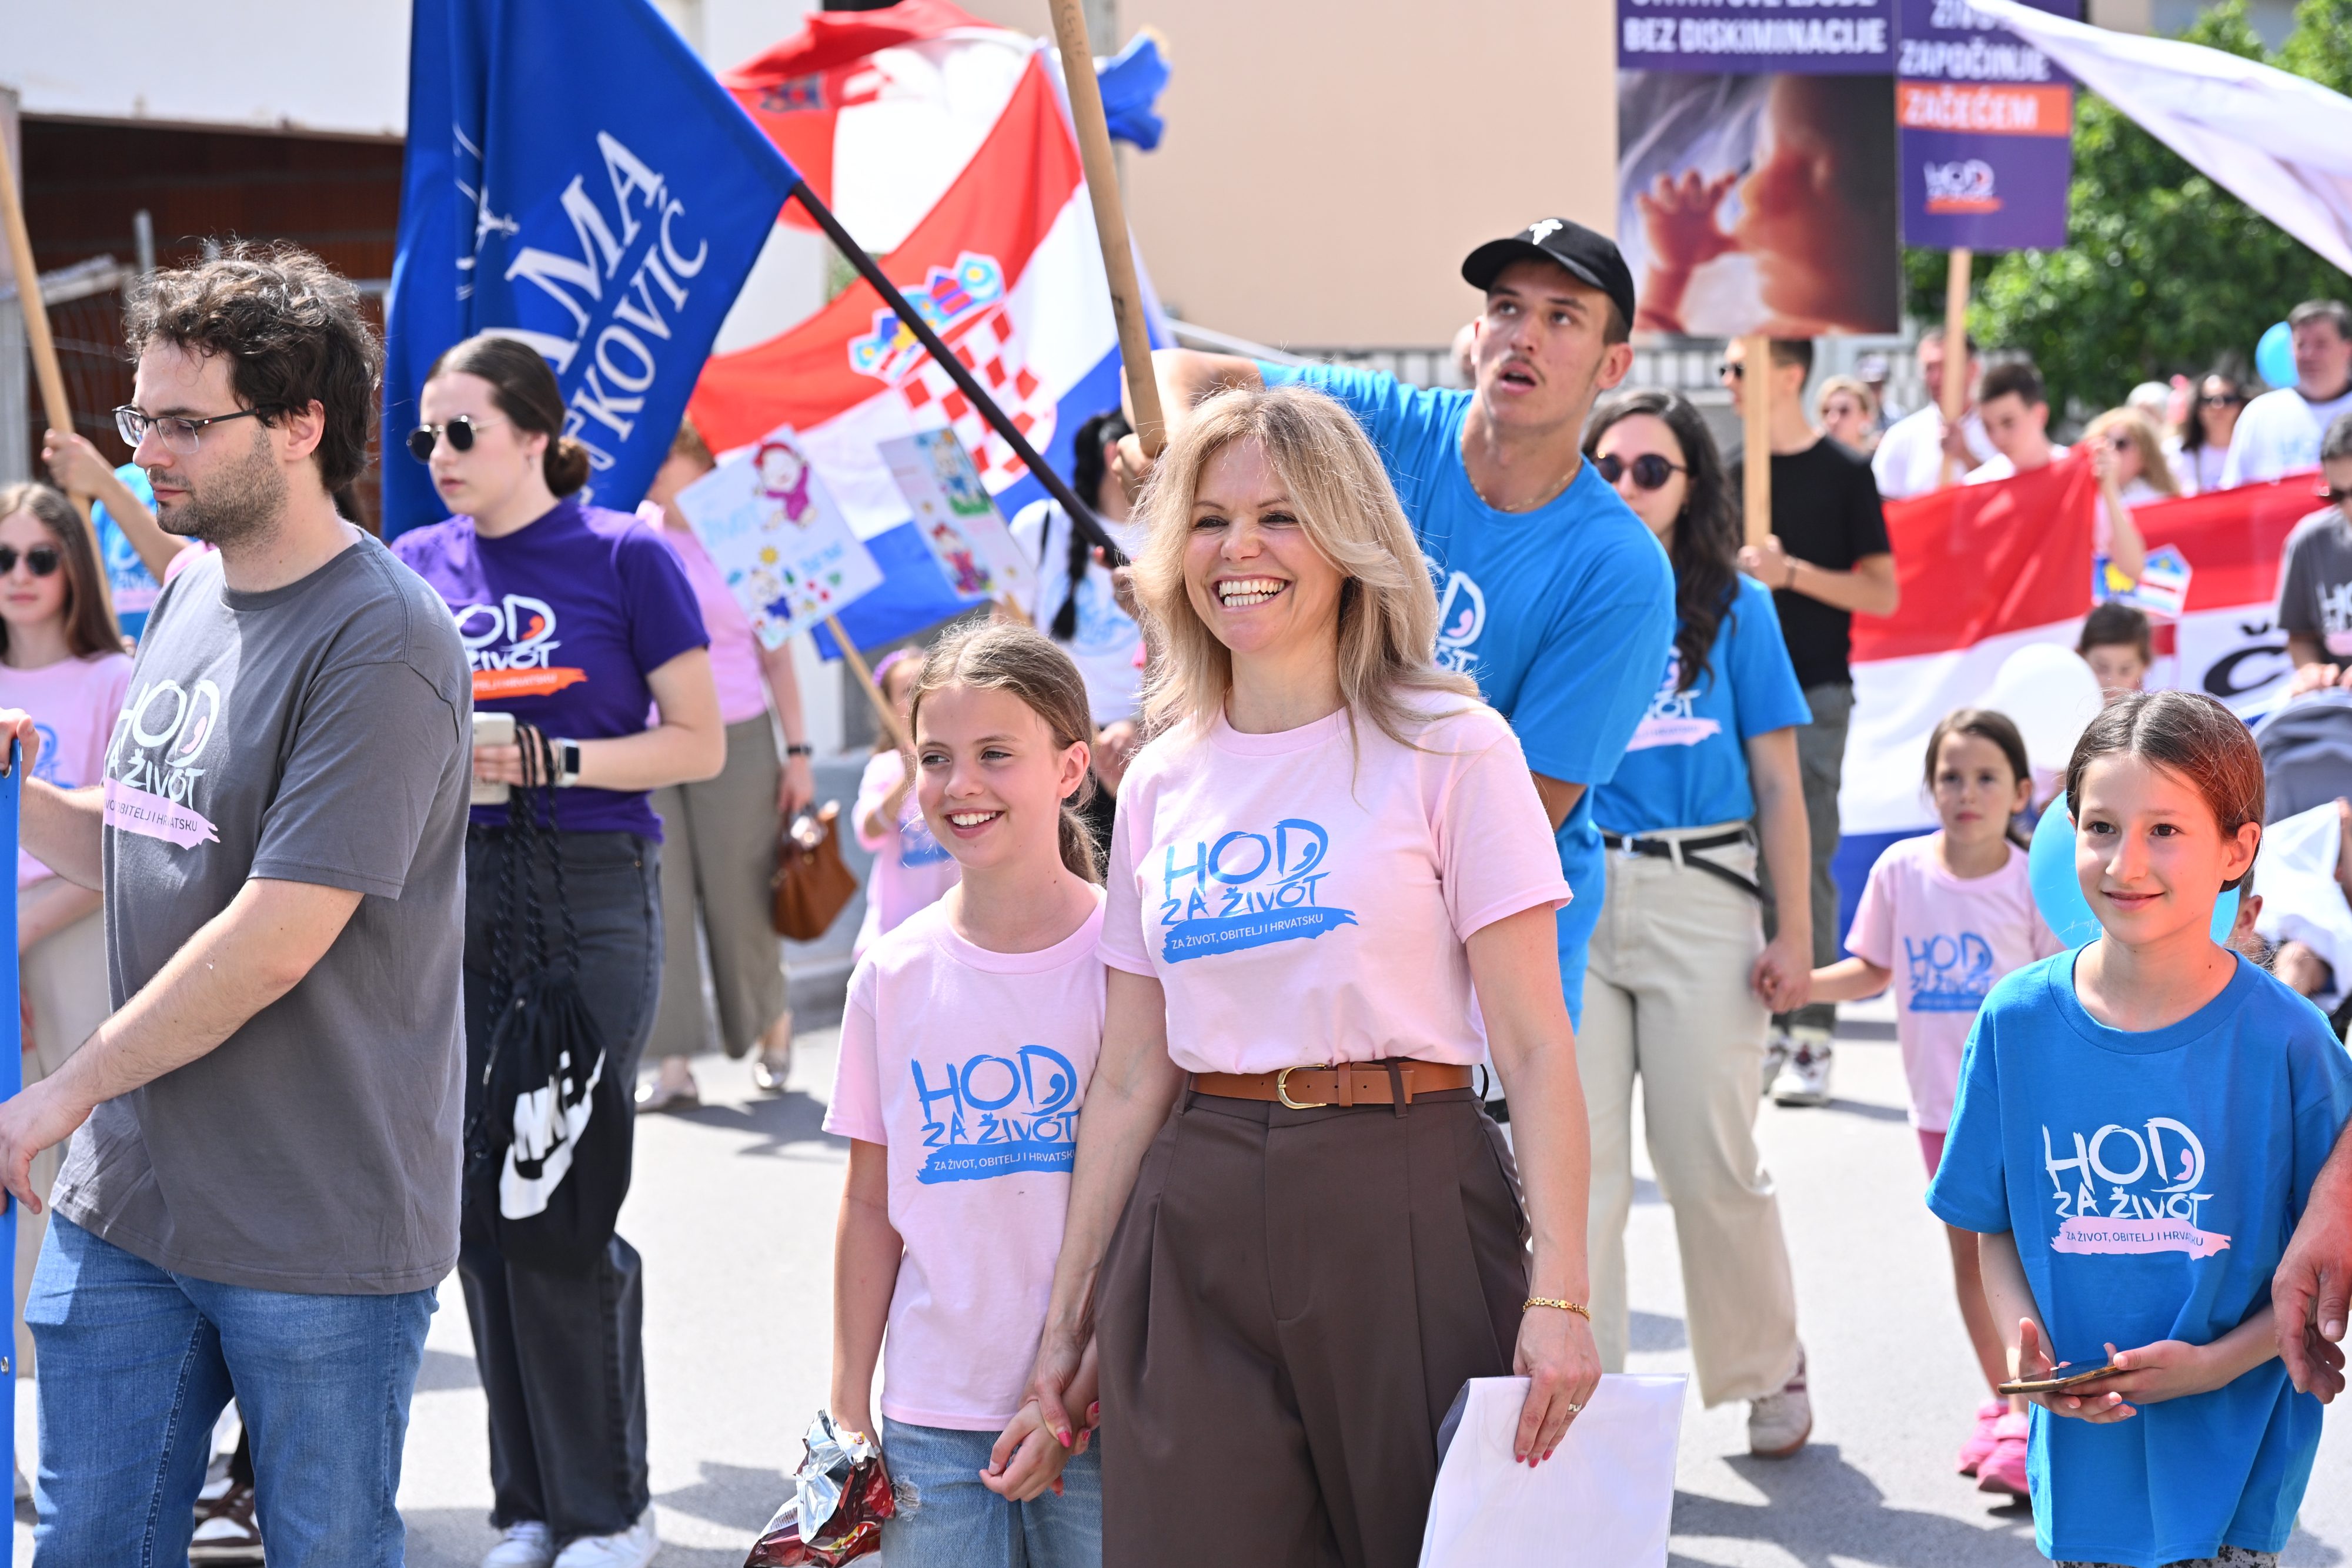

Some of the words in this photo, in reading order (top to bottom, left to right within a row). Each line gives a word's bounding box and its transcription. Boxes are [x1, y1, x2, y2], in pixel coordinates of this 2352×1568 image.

[1623, 16, 1678, 52] BEZ
[1897, 35, 2051, 81] ZAPOČINJE
[121, 747, 206, 811] ŽIVOT
[156, 813, 198, 832] HRVATSKU
[1163, 818, 1329, 900] HOD
[1160, 887, 1210, 925] ZA
[1218, 871, 1332, 918] ŽIVOT
[1171, 940, 1185, 950] ZA
[1186, 932, 1220, 948] ŽIVOT,
[1220, 925, 1263, 941] OBITELJ
[1265, 924, 1268, 934] I
[1269, 913, 1324, 932] HRVATSKU
[1904, 931, 1993, 978] HOD
[911, 1044, 1077, 1124] HOD
[920, 1111, 969, 1148] ZA
[977, 1107, 1083, 1144] ŽIVOT
[934, 1161, 947, 1171] ZA
[948, 1159, 977, 1169] ŽIVOT,
[979, 1152, 1021, 1166] OBITELJ
[1023, 1152, 1026, 1161] I
[2042, 1116, 2205, 1195] HOD
[2052, 1182, 2101, 1218] ZA
[2109, 1185, 2214, 1229] ŽIVOT
[2066, 1231, 2076, 1241] ZA
[2077, 1231, 2112, 1242] ŽIVOT,
[2113, 1232, 2154, 1242] OBITELJ
[2157, 1232, 2160, 1241] I
